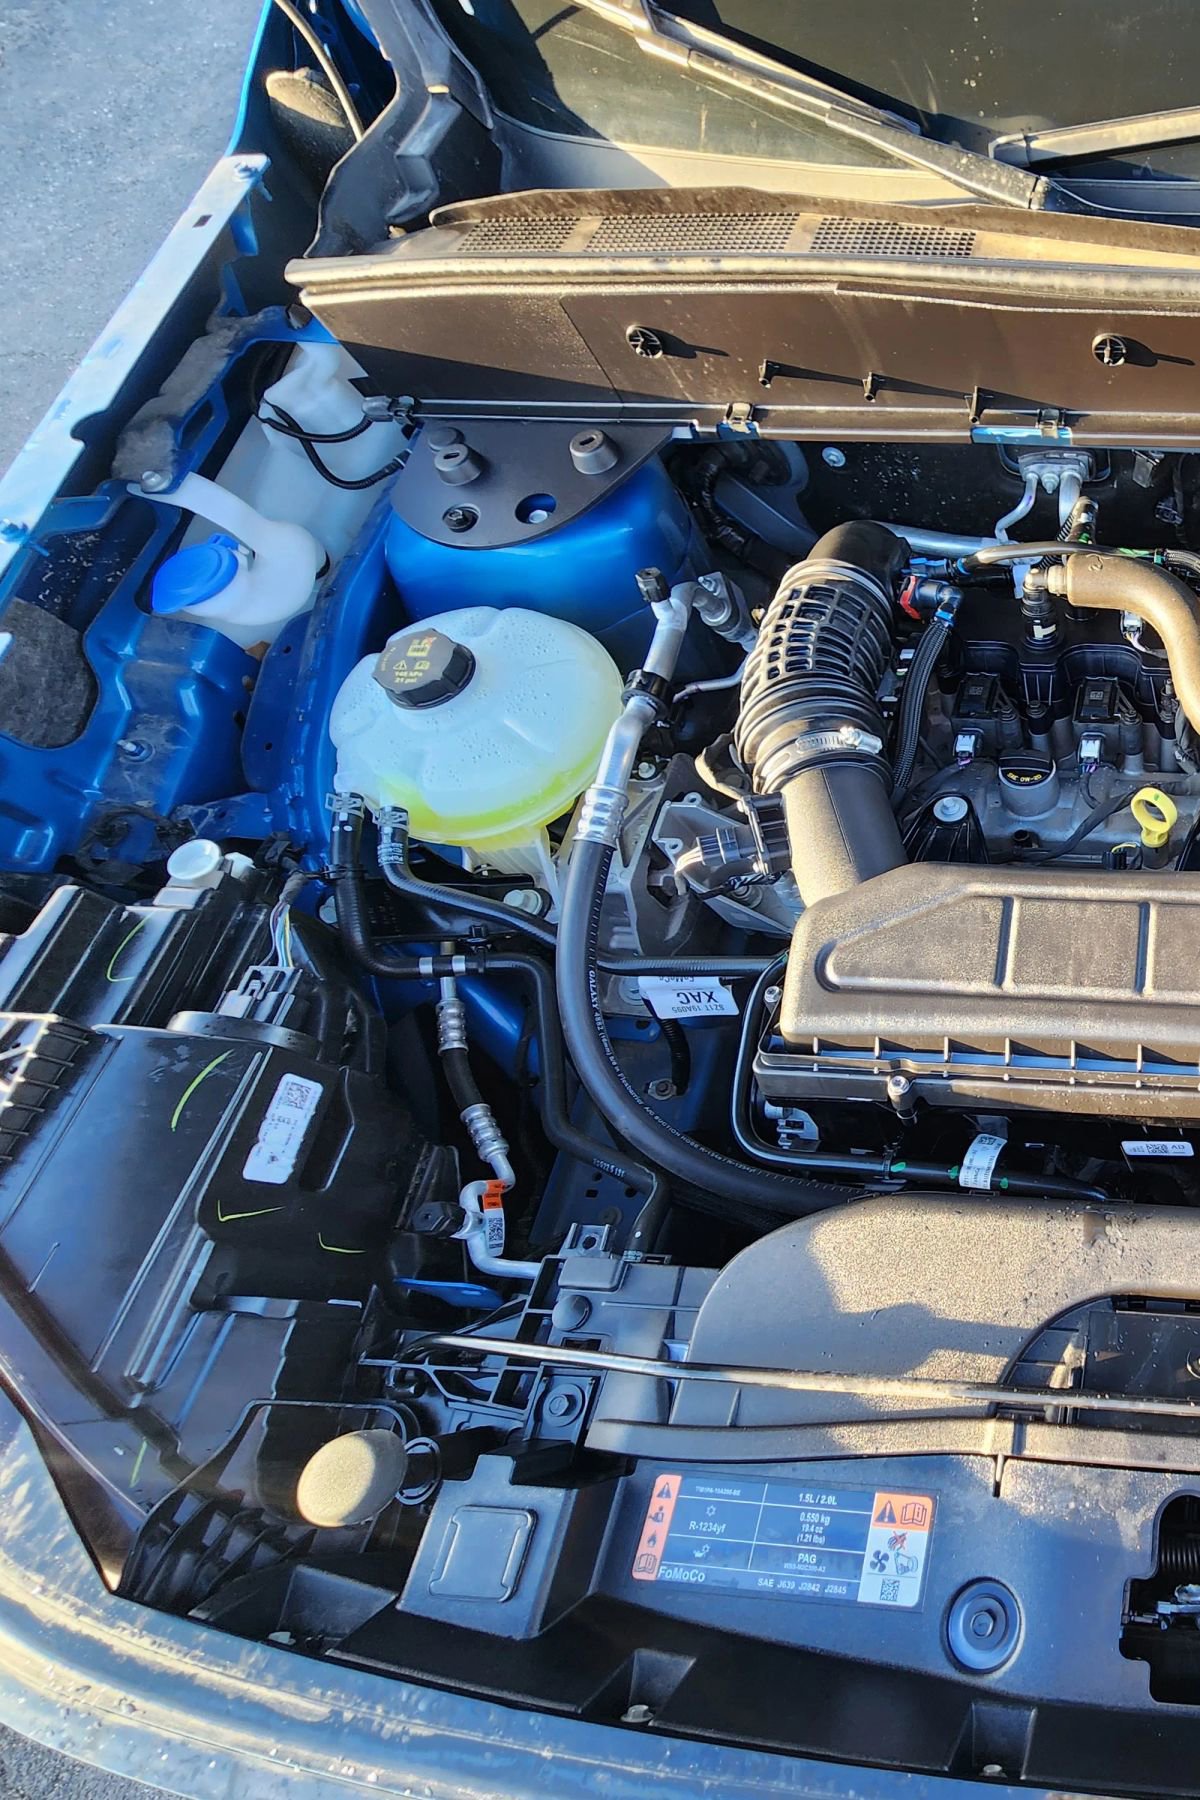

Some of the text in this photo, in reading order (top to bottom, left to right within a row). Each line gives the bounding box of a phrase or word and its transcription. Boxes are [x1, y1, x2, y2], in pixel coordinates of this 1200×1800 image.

[678, 991, 719, 1004] XAC
[588, 970, 599, 1010] GALAXY
[654, 1115, 681, 1138] SUCTION
[798, 1493, 815, 1503] 1.5L
[820, 1495, 838, 1505] 2.0L
[799, 1512, 831, 1526] 0.550 kg
[688, 1520, 726, 1535] R-1234yf
[801, 1523, 815, 1532] 19.4
[796, 1533, 826, 1545] (1.21 lbs)
[797, 1553, 817, 1564] PAG
[657, 1566, 706, 1583] FoMoCo
[757, 1578, 847, 1594] SAE J639 J2842 J2845
